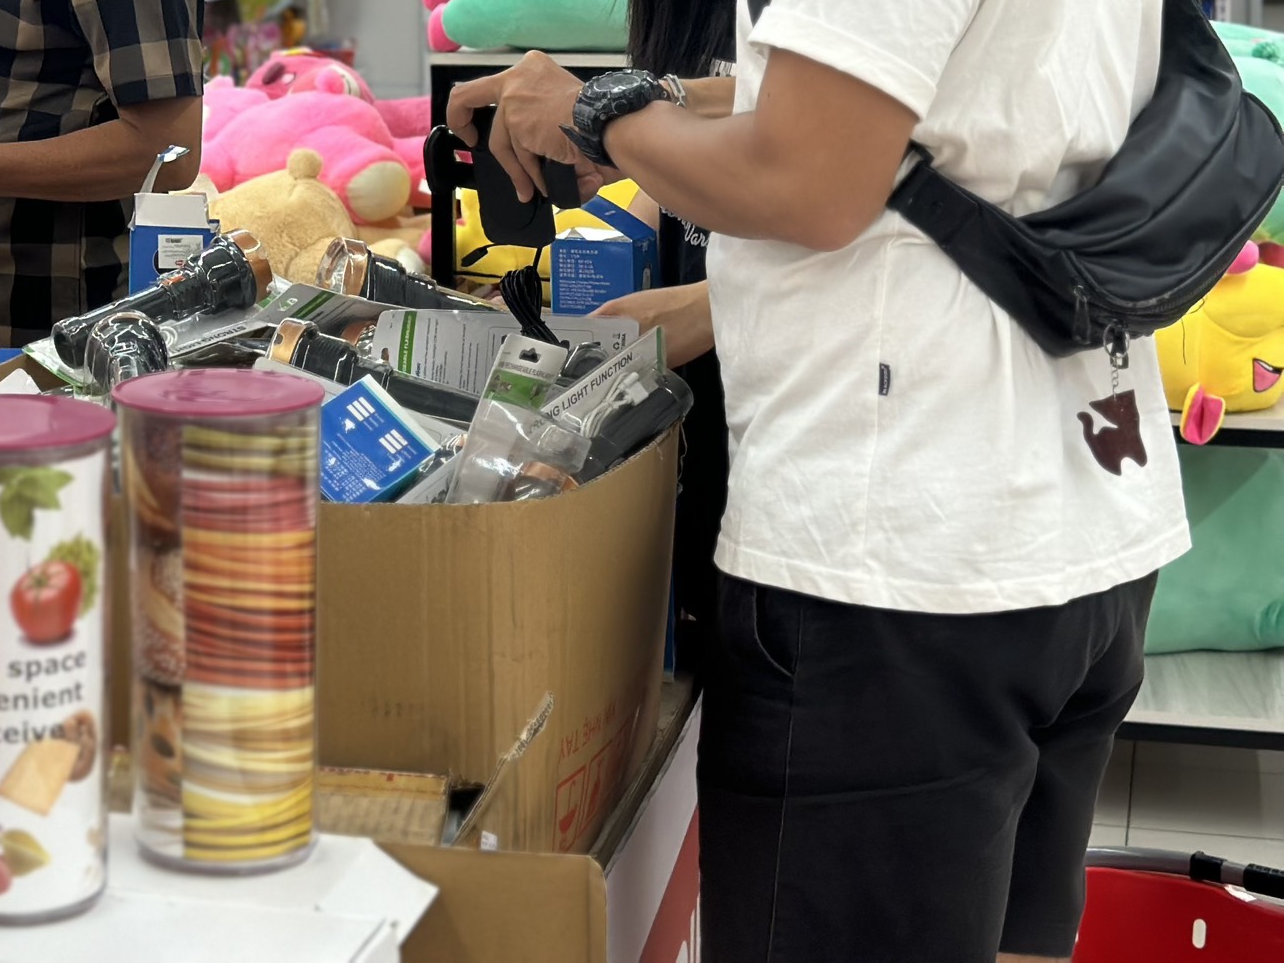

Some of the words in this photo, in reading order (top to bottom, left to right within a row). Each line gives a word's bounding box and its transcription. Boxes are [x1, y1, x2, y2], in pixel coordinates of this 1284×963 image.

[562, 385, 589, 411] LIGHT
[590, 352, 633, 391] FUNCTION
[7, 650, 87, 682] space
